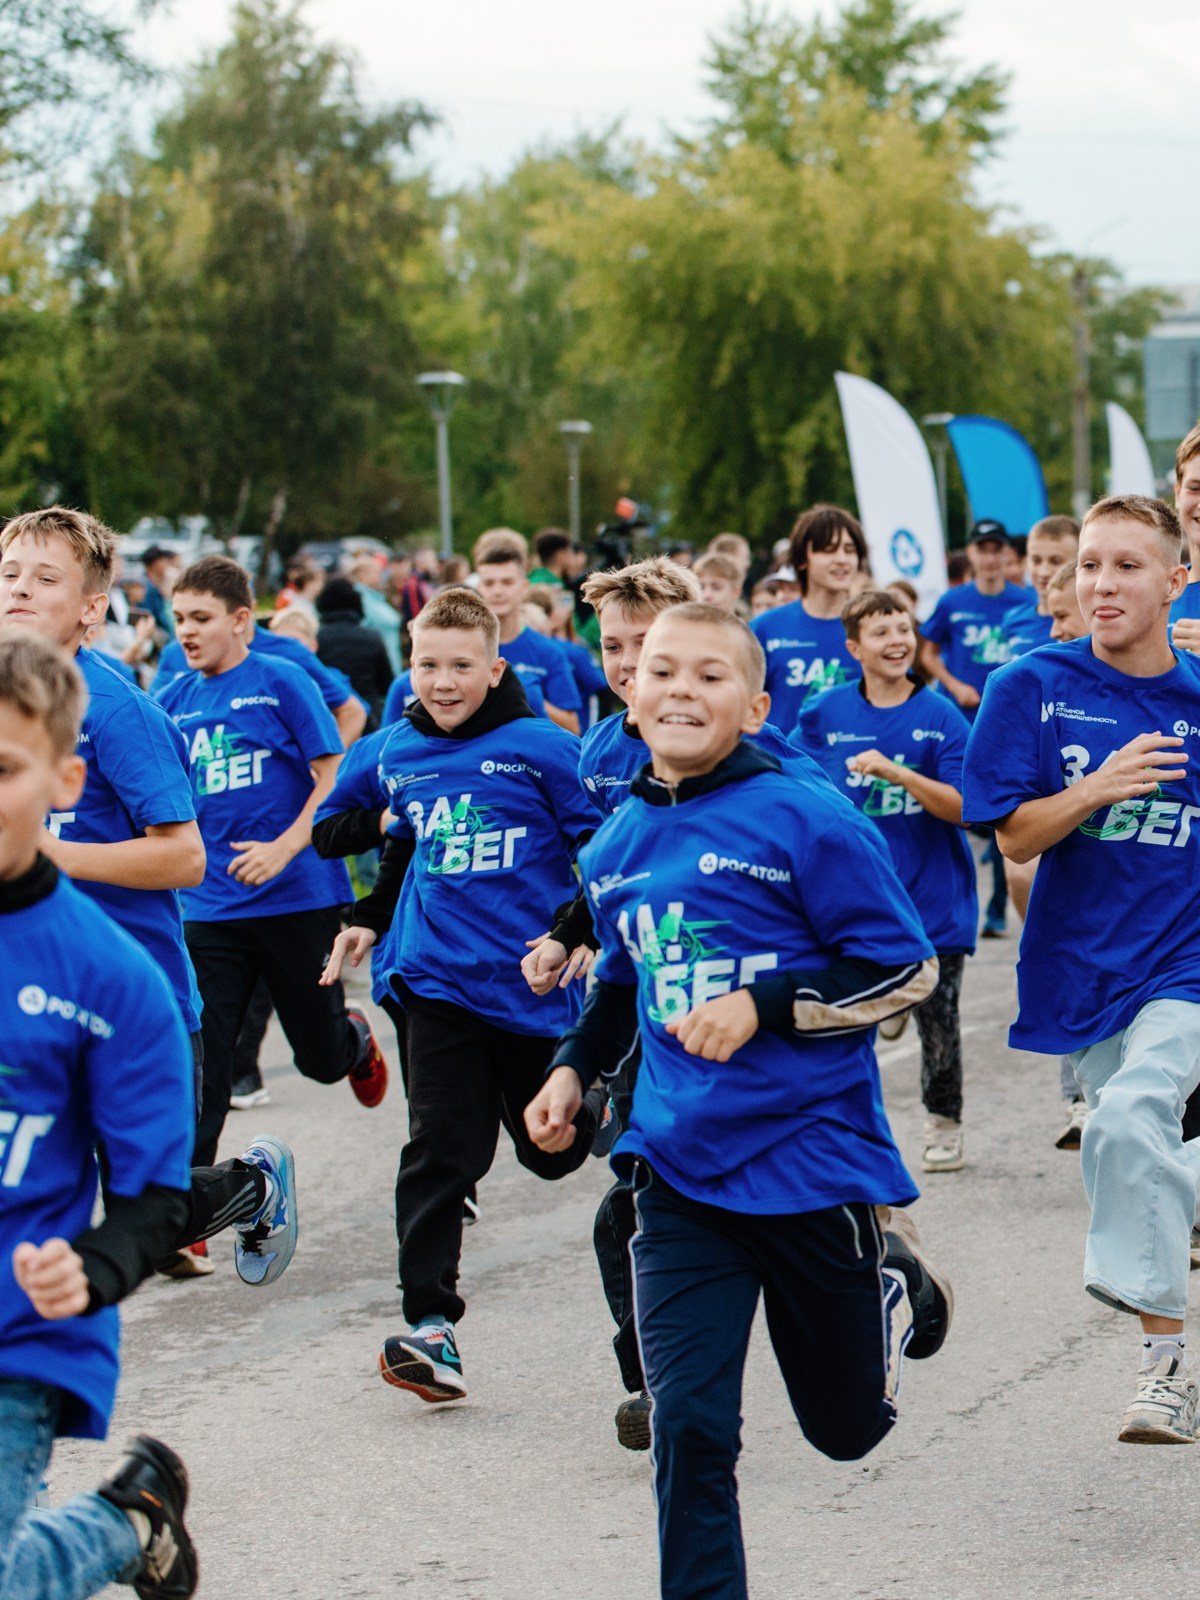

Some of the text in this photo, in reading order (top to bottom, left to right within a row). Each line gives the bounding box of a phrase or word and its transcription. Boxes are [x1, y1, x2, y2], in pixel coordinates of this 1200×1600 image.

[786, 657, 841, 687] ЗА!
[205, 749, 272, 796] БЕГ
[496, 762, 542, 779] РОСАТОМ
[442, 826, 527, 875] БЕГ
[718, 857, 791, 884] РОСАТОМ
